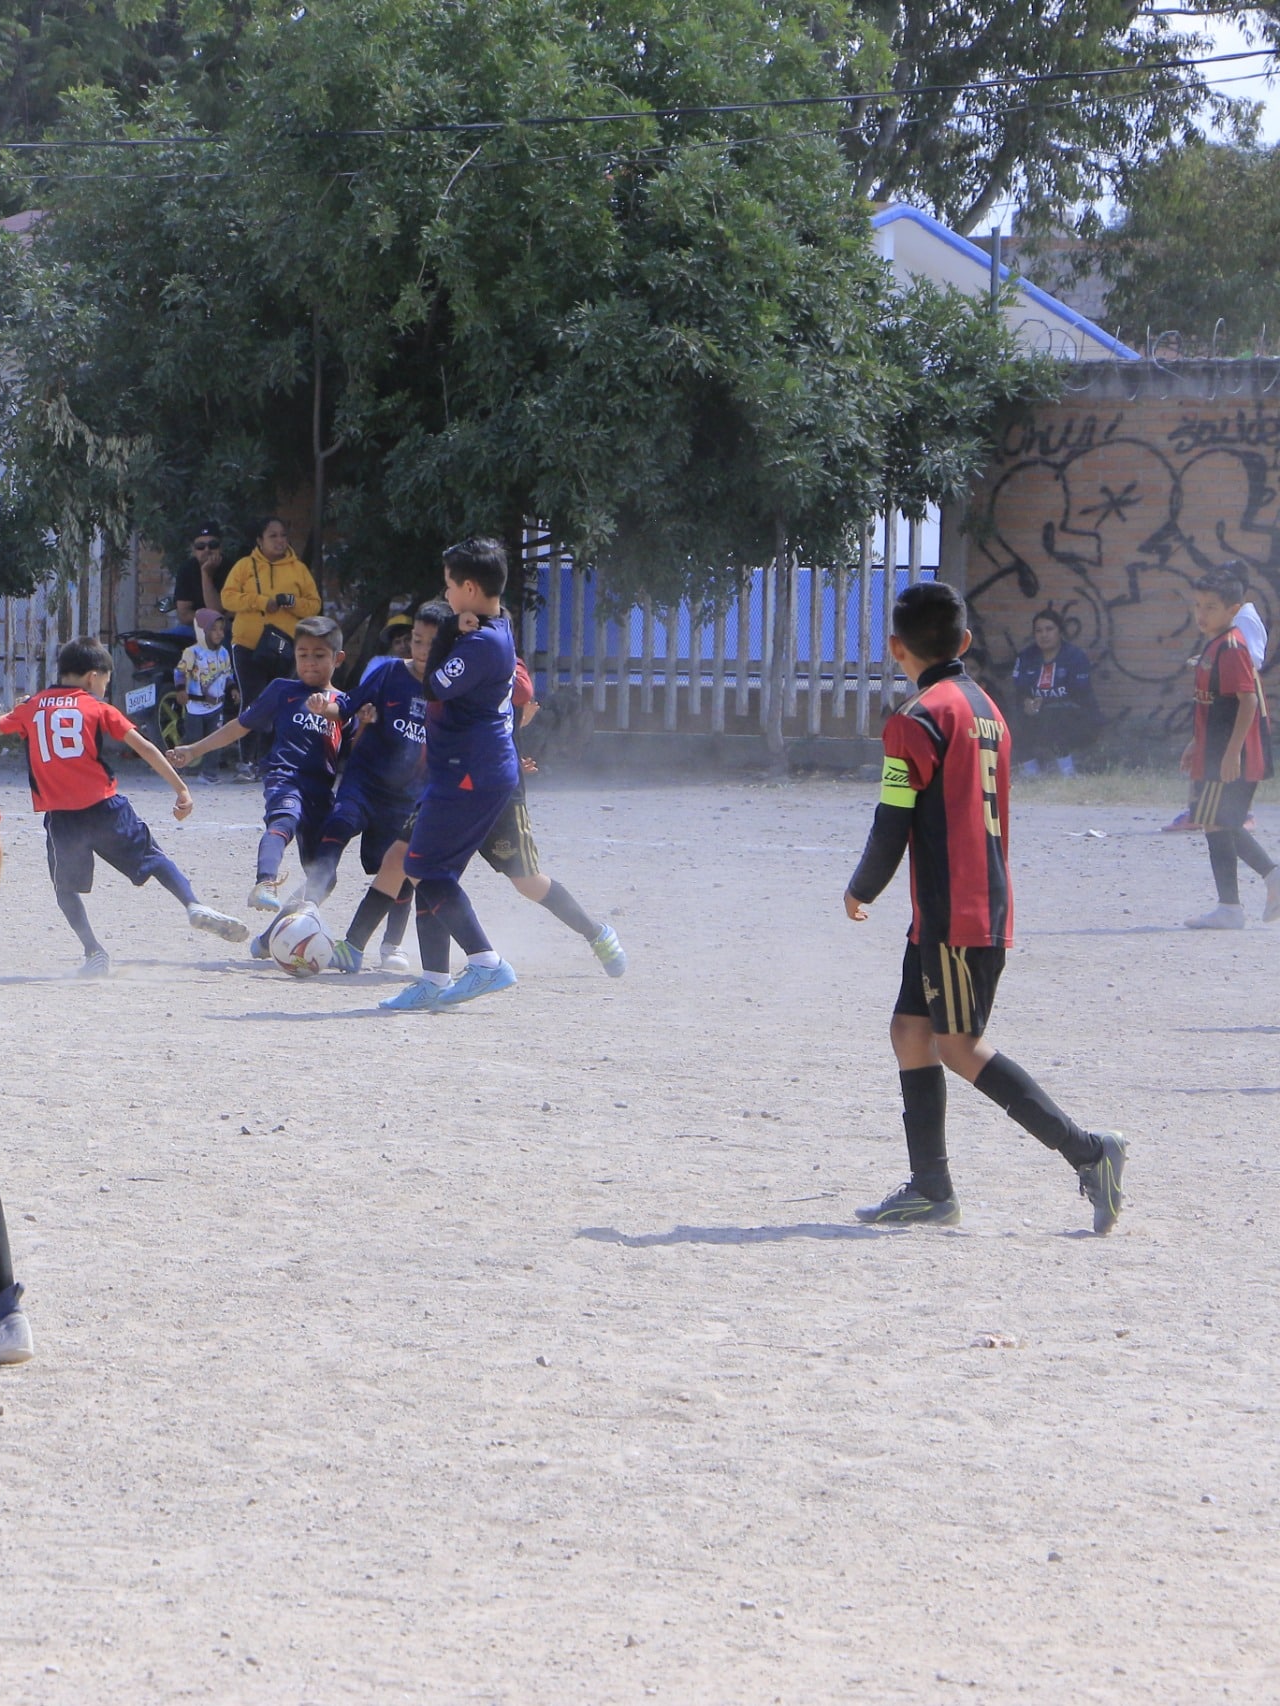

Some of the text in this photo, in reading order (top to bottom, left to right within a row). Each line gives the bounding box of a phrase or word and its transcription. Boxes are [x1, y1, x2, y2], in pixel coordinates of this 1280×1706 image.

[38, 696, 78, 709] NAGAI
[32, 708, 85, 763] 18
[393, 718, 427, 737] QATA
[968, 716, 1005, 742] JONY
[403, 731, 427, 744] AIRWA
